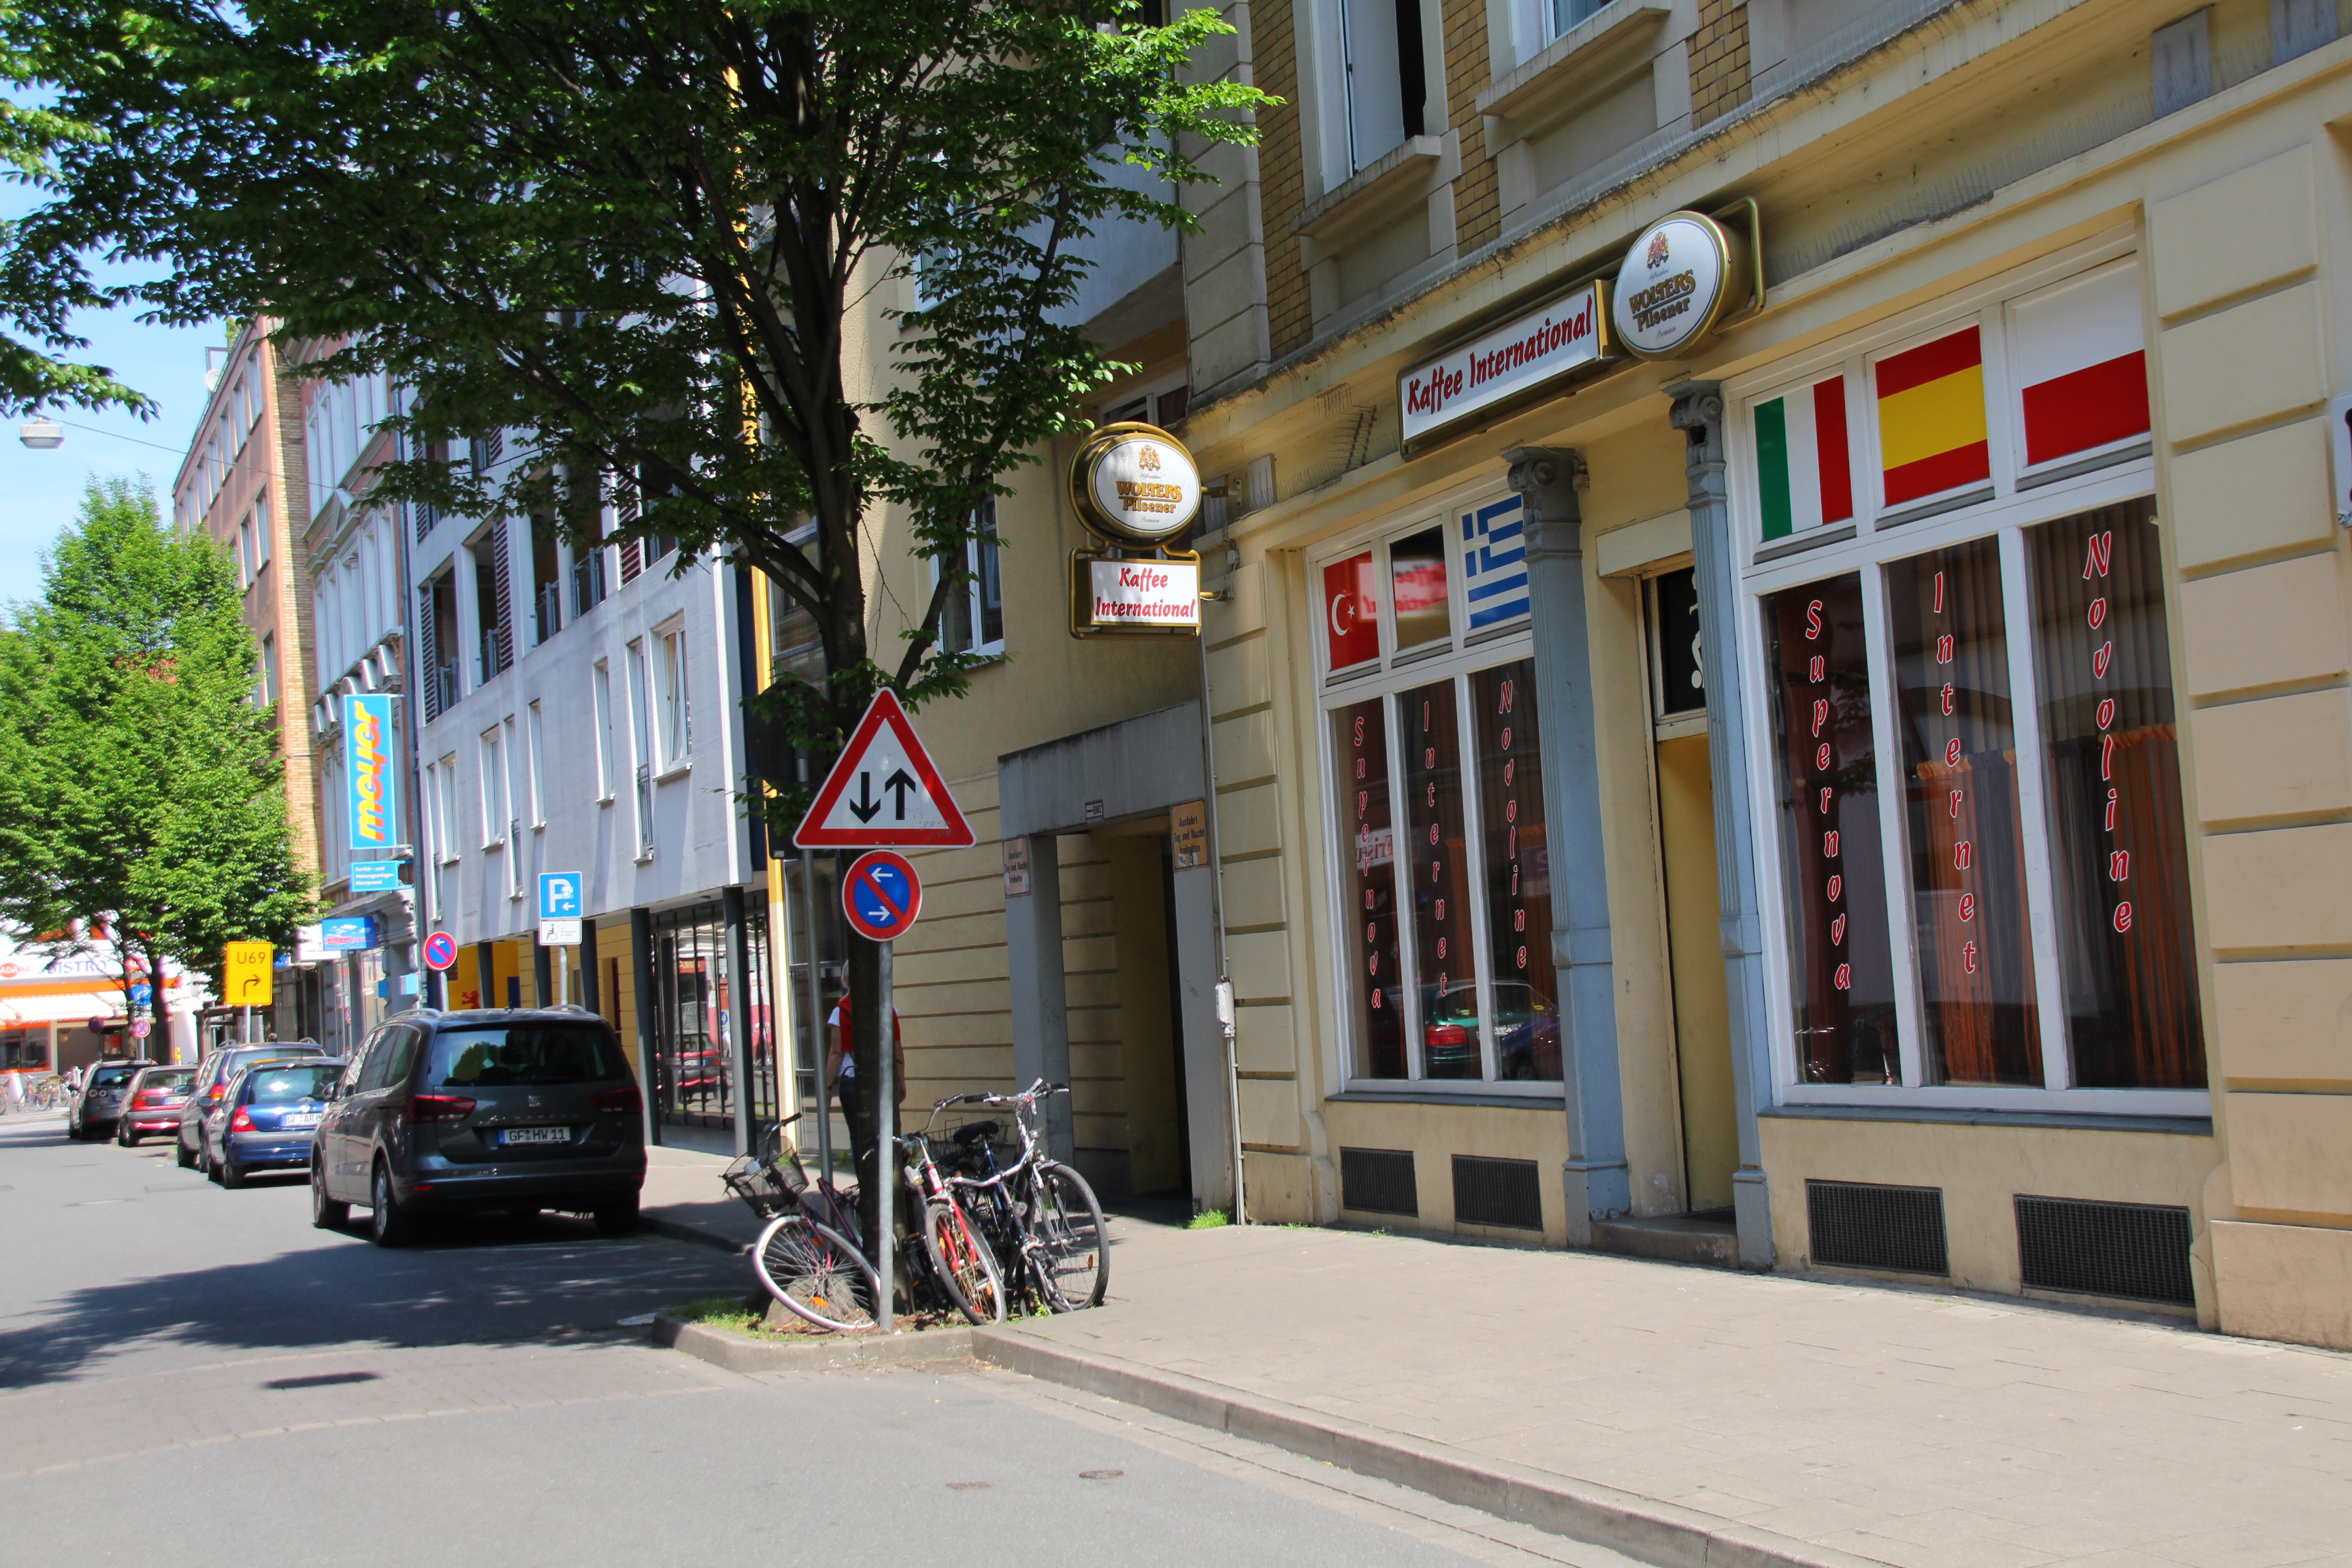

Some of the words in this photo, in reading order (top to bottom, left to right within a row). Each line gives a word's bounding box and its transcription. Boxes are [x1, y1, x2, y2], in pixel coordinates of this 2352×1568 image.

[1629, 269, 1696, 314] WOLTERS
[1636, 297, 1690, 332] Pilsener
[1407, 365, 1463, 415] Kaffee
[1469, 294, 1592, 389] International
[1116, 480, 1182, 502] WOLTERS
[1123, 497, 1176, 513] Pilsener
[1119, 568, 1169, 592] Kaffee
[1095, 597, 1196, 617] International
[2082, 530, 2133, 934] Novoline
[355, 700, 387, 842] meyer
[1933, 570, 1976, 975] Internet
[1805, 599, 1850, 990] Supernova
[1179, 815, 1198, 827] Ausfahrt
[1499, 679, 1526, 968] Novoline
[1181, 830, 1190, 840] und
[1191, 828, 1205, 838] Nacht
[1179, 844, 1200, 855] freihalten
[1423, 701, 1447, 997] Internet
[1354, 716, 1382, 1009] Supernova
[48, 960, 107, 975] BISTRO
[238, 951, 266, 964] U69
[0, 965, 31, 975] ADANA
[509, 1130, 524, 1141] GF
[532, 1128, 548, 1140] HW
[551, 1128, 566, 1139] 11
